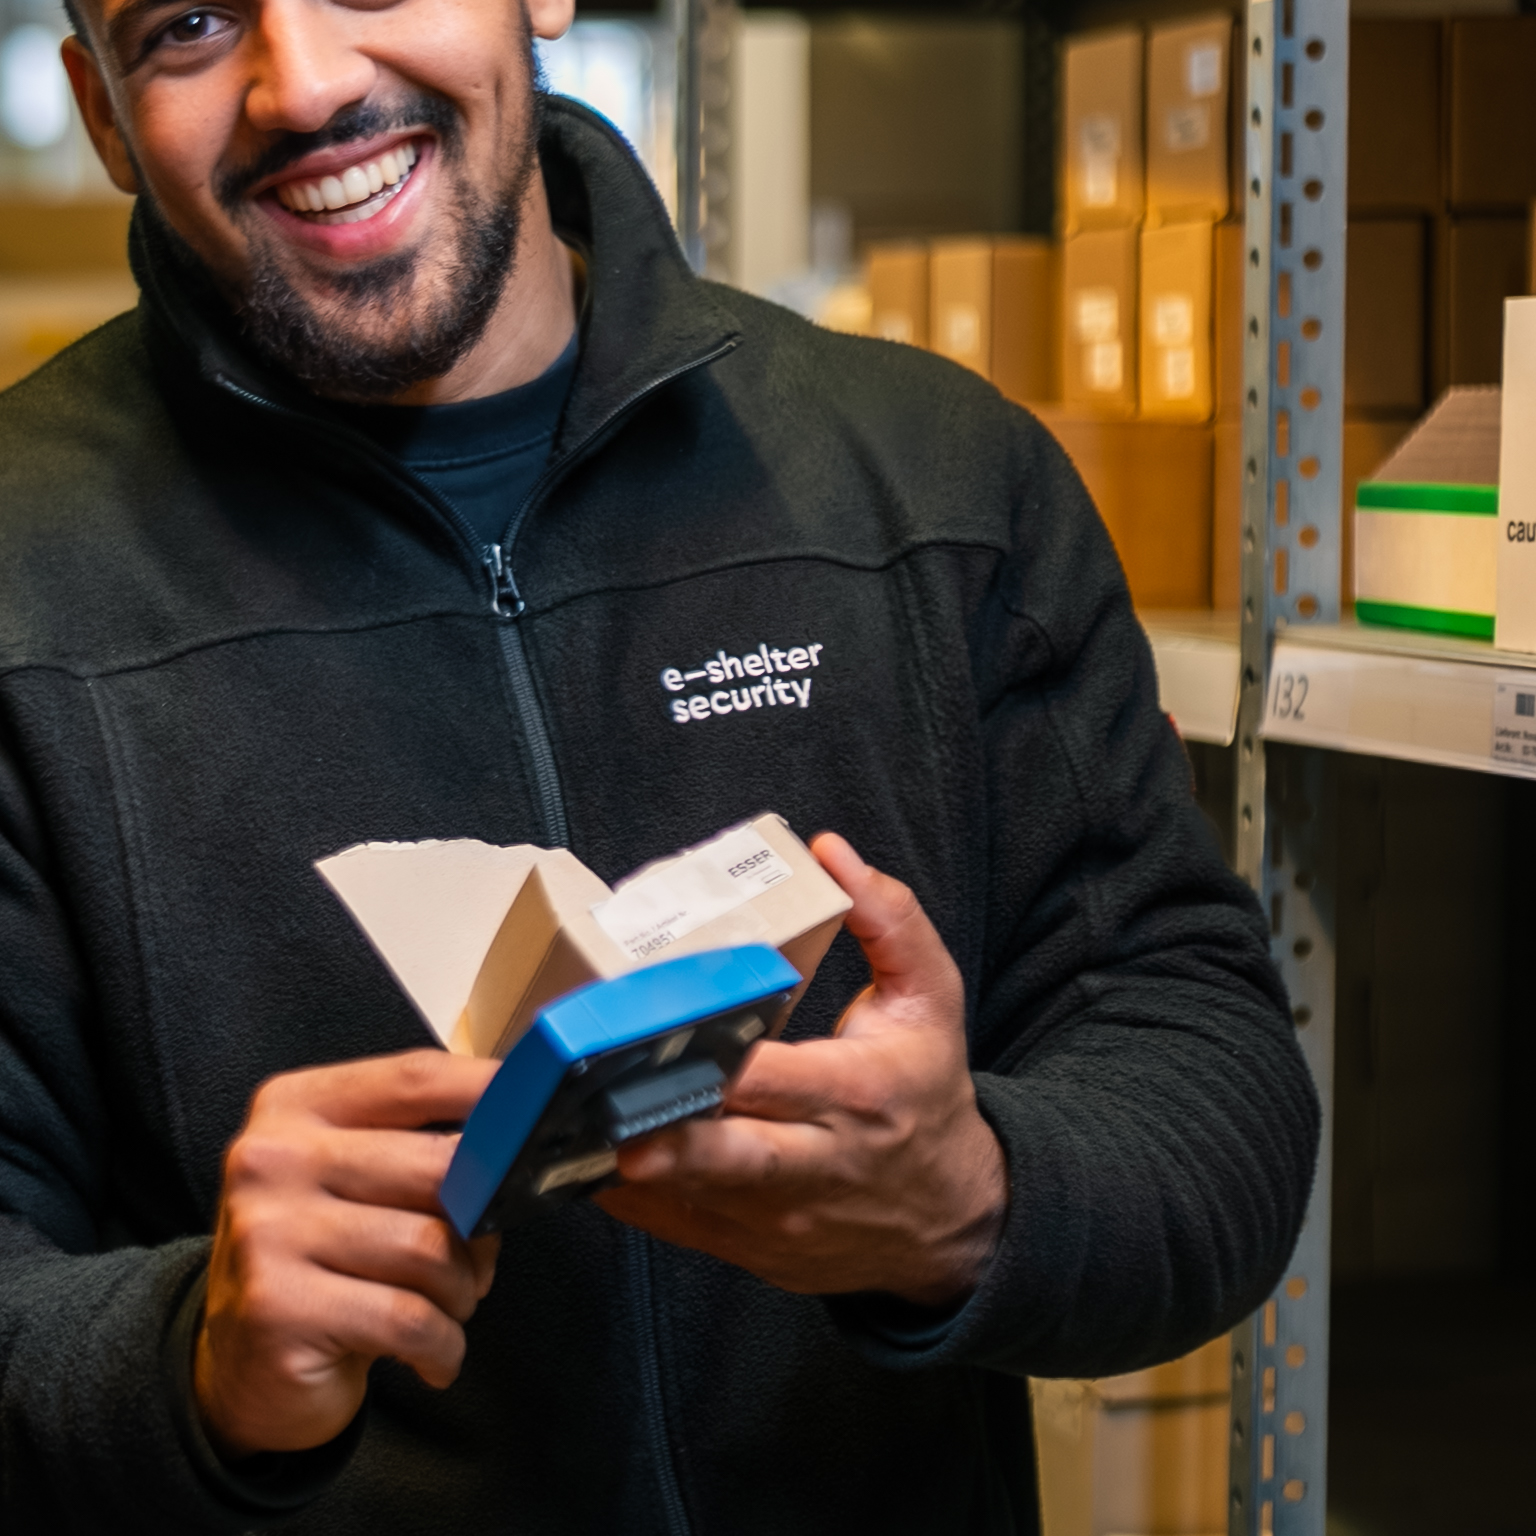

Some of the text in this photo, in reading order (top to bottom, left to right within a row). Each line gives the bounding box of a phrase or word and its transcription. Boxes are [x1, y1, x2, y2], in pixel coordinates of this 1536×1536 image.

[661, 642, 823, 691] e-shelter
[669, 676, 812, 723] security
[1272, 672, 1310, 721] 132
[728, 849, 775, 878] ESSER
